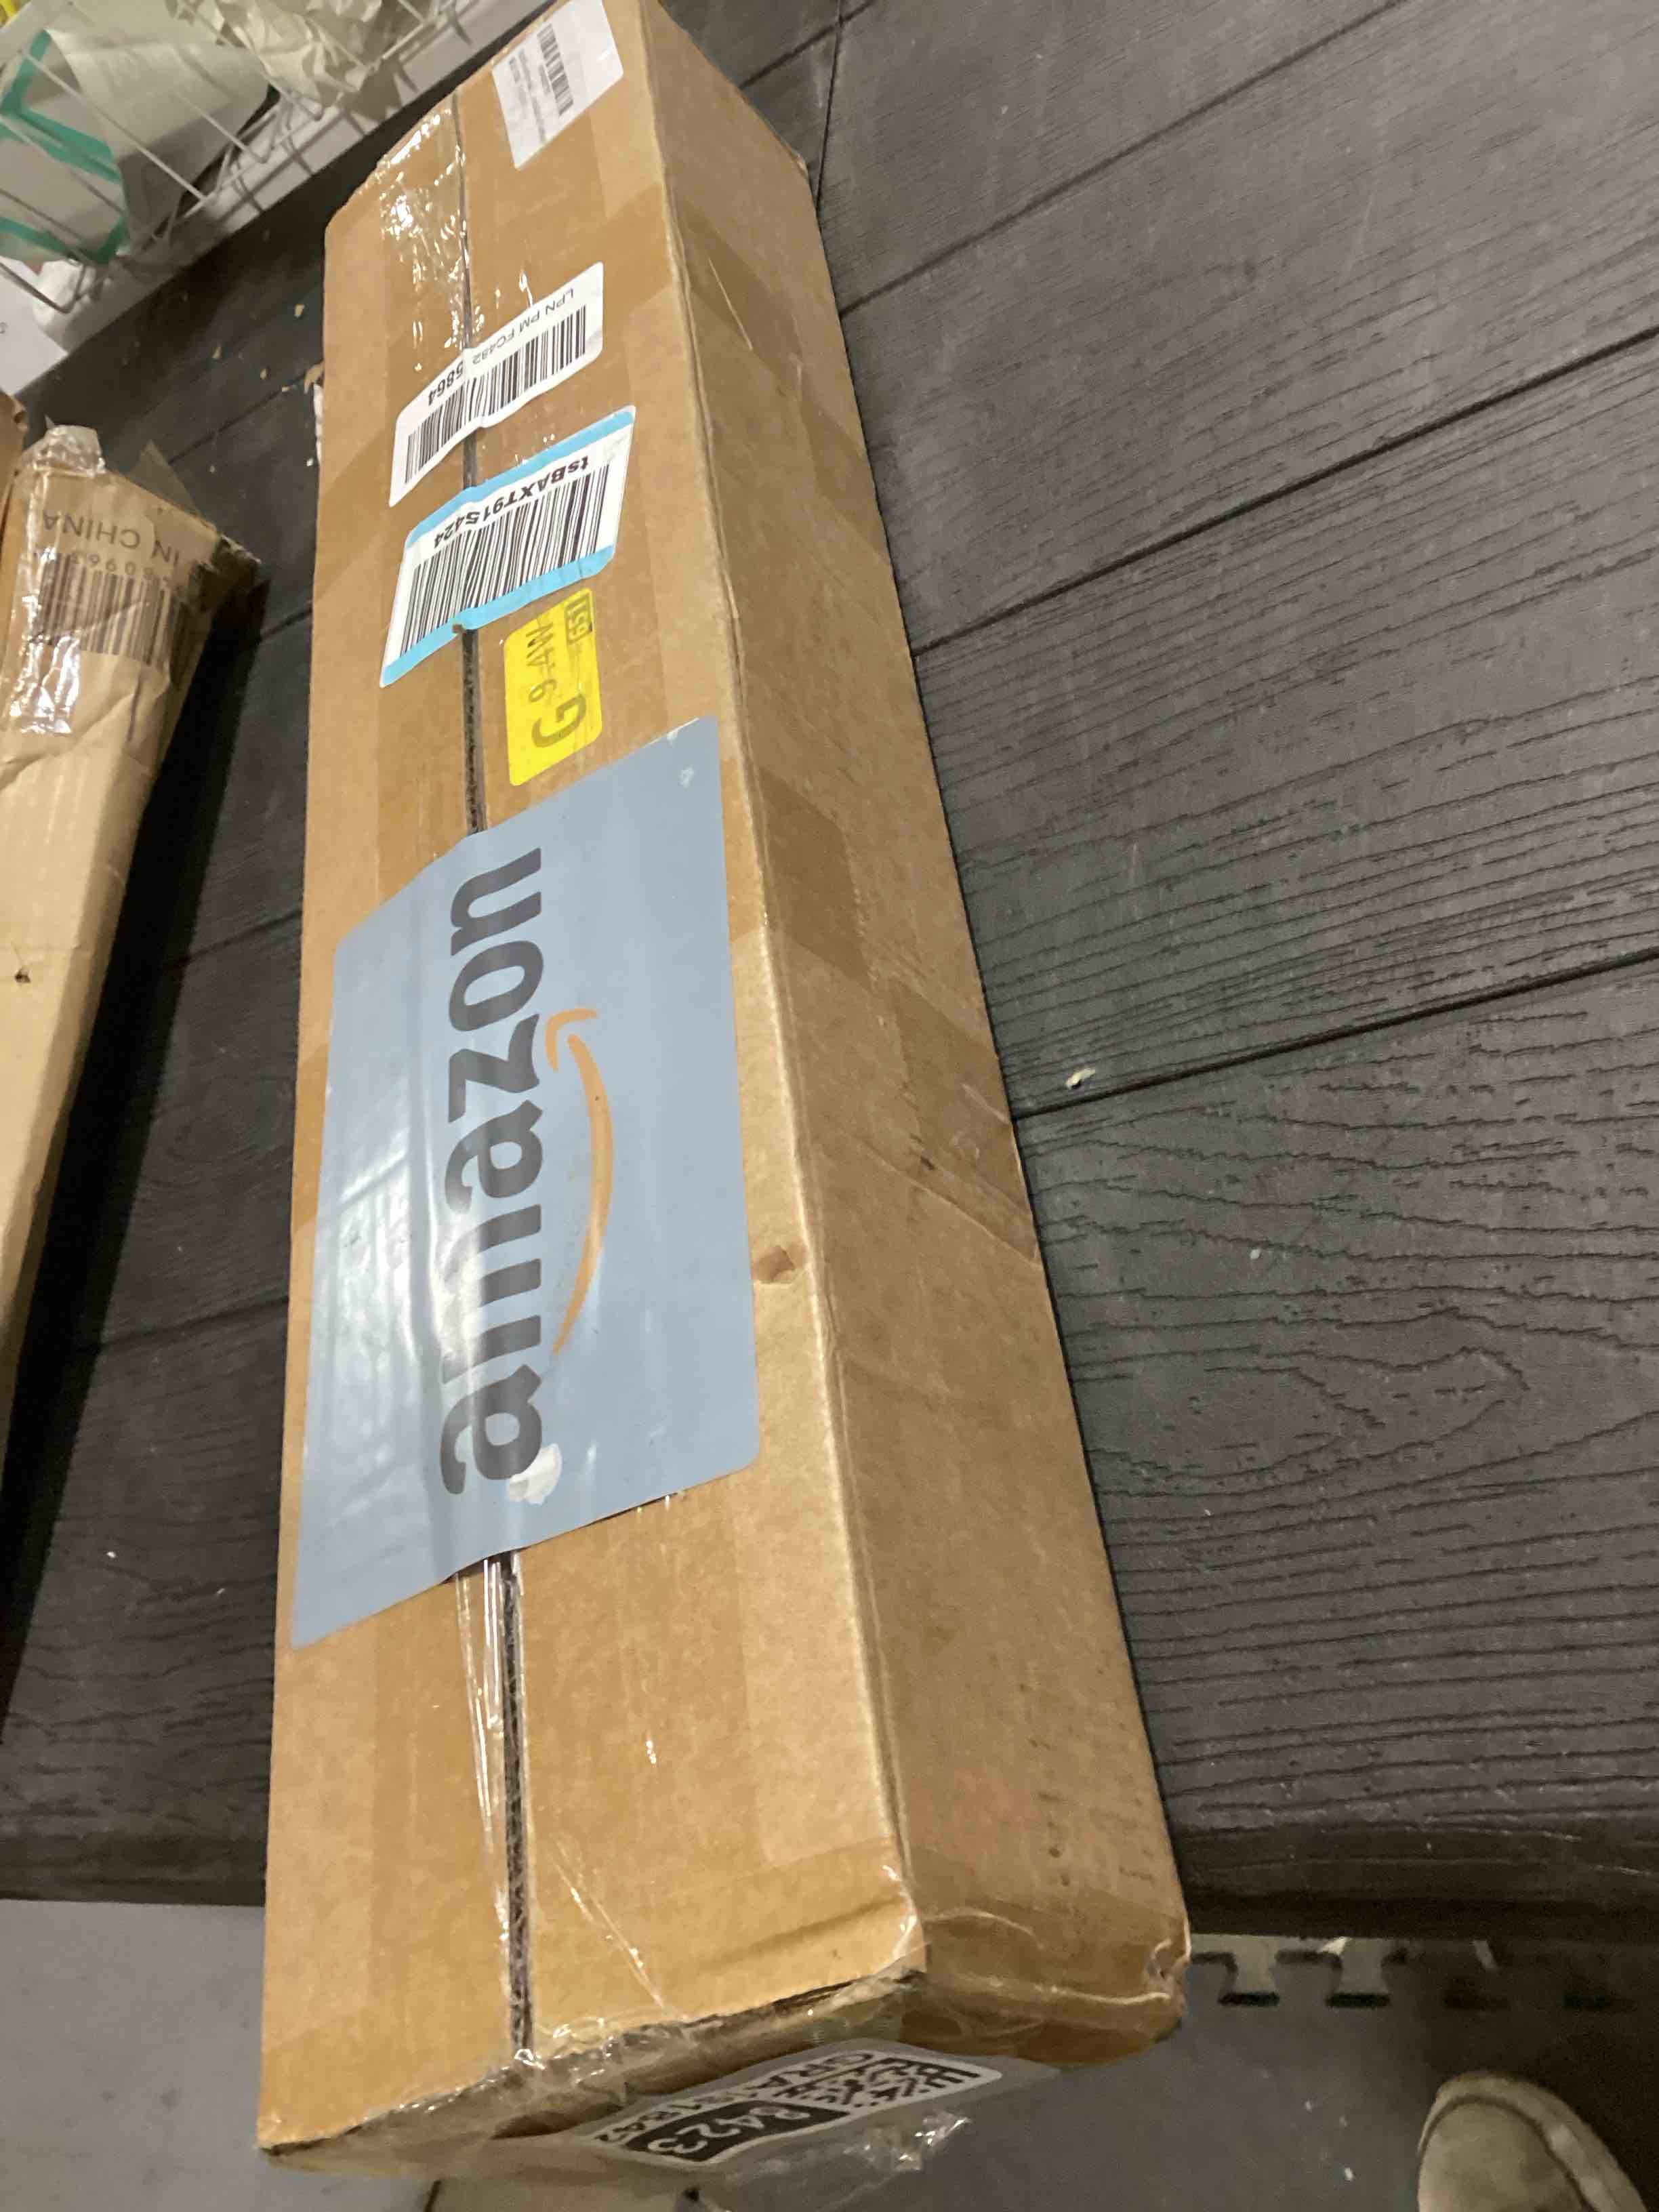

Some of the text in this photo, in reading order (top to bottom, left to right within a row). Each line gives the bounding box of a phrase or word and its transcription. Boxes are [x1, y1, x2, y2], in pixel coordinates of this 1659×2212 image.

[519, 310, 540, 333] PM
[546, 287, 574, 315] LPN
[428, 361, 464, 406] 5864
[43, 513, 180, 565] IN CHINA
[531, 693, 587, 748] G
[440, 846, 544, 1496] amazon
